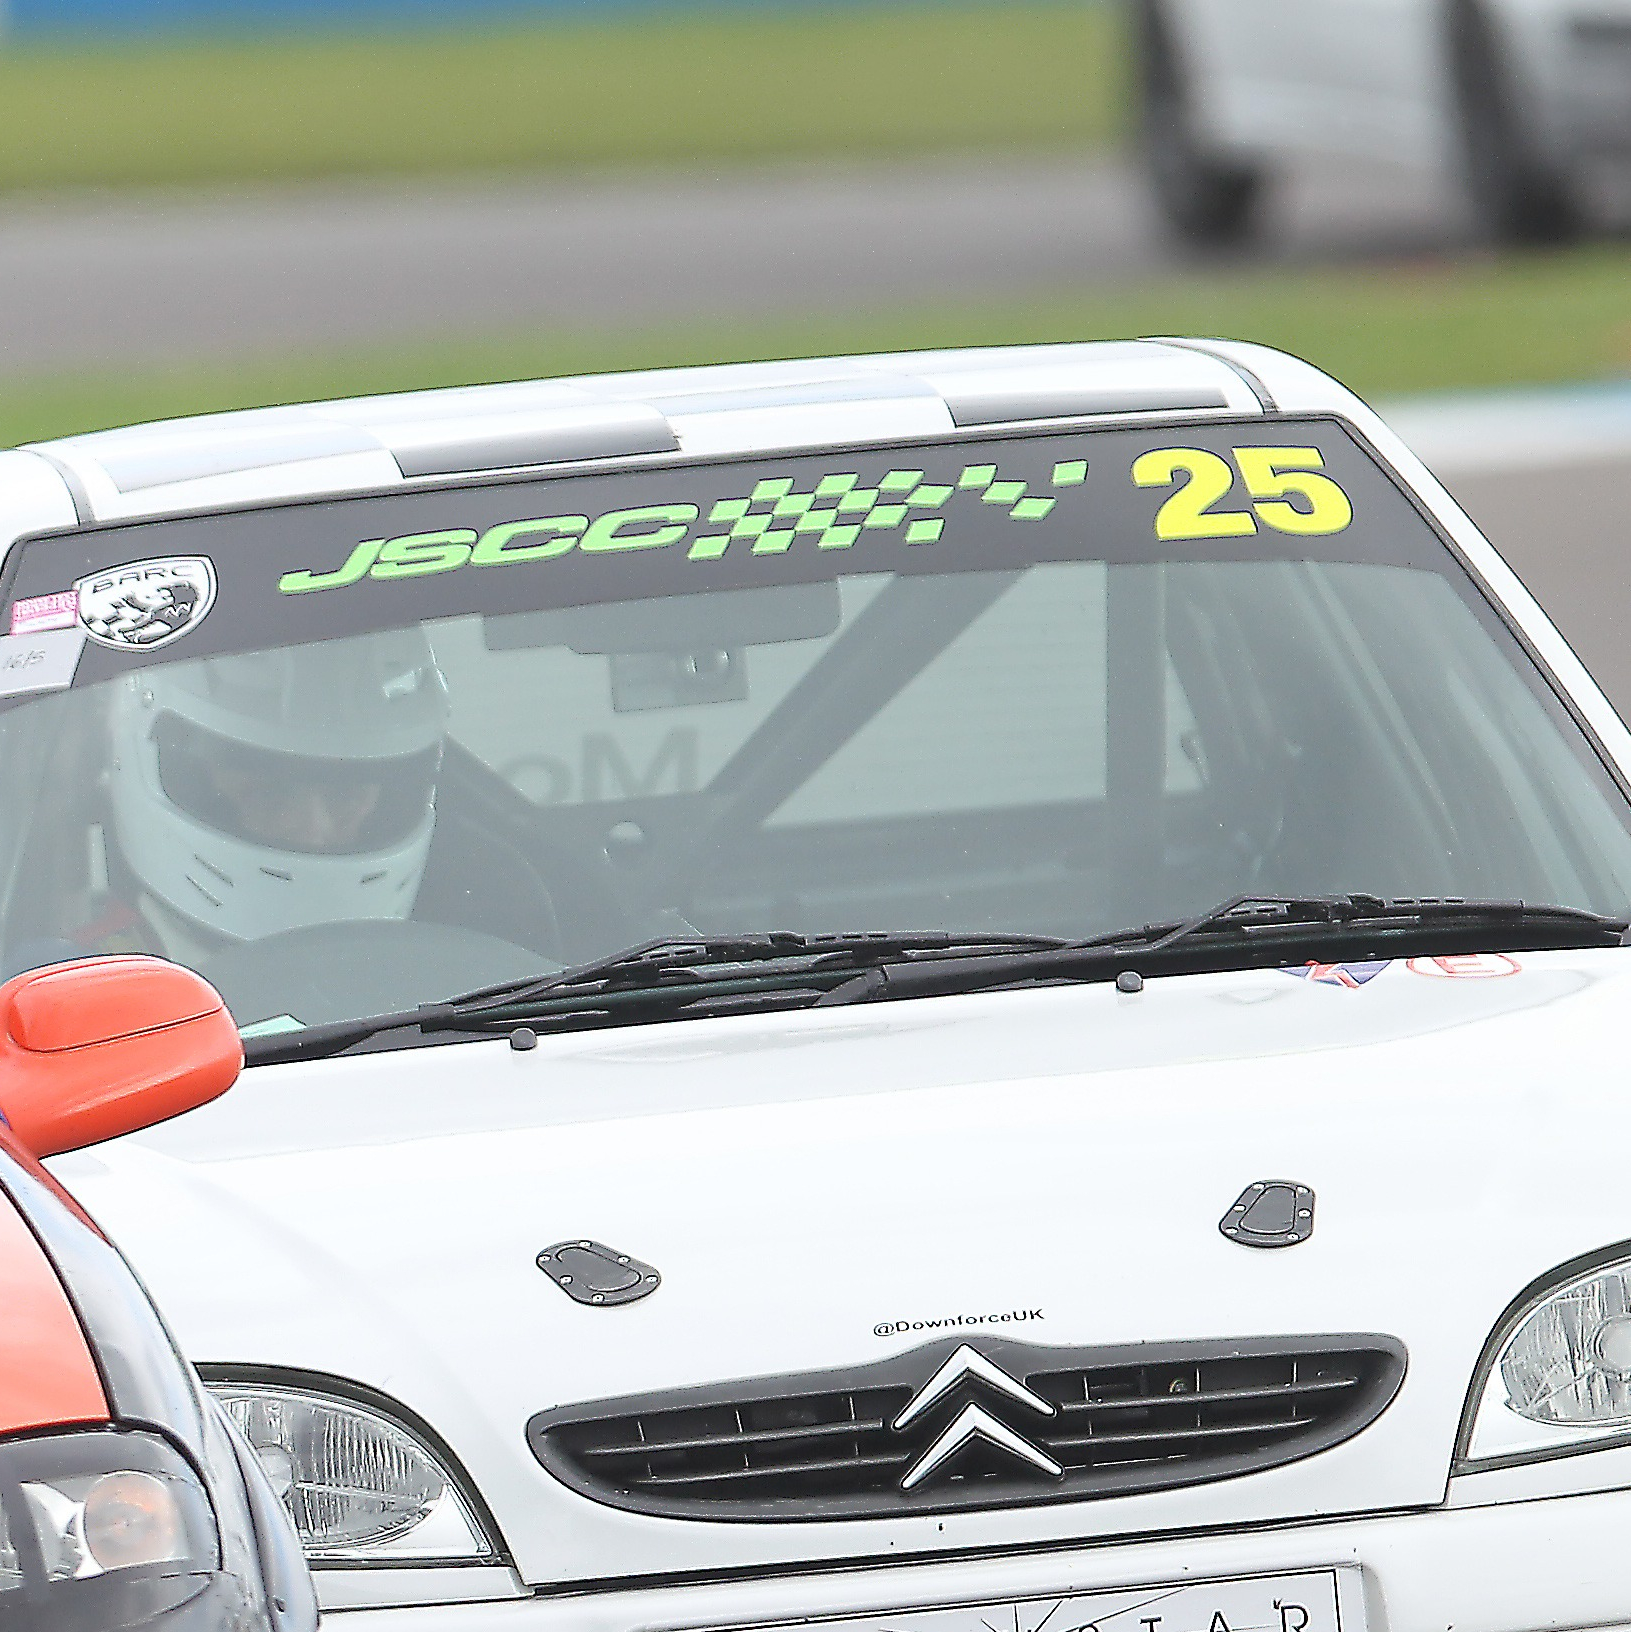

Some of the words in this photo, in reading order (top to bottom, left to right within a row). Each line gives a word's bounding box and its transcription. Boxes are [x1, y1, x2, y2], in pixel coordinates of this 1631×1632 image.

[1131, 445, 1353, 542] 25
[93, 565, 193, 593] BARC
[278, 500, 699, 596] JSCC
[873, 1309, 1045, 1337] @DownforceUK
